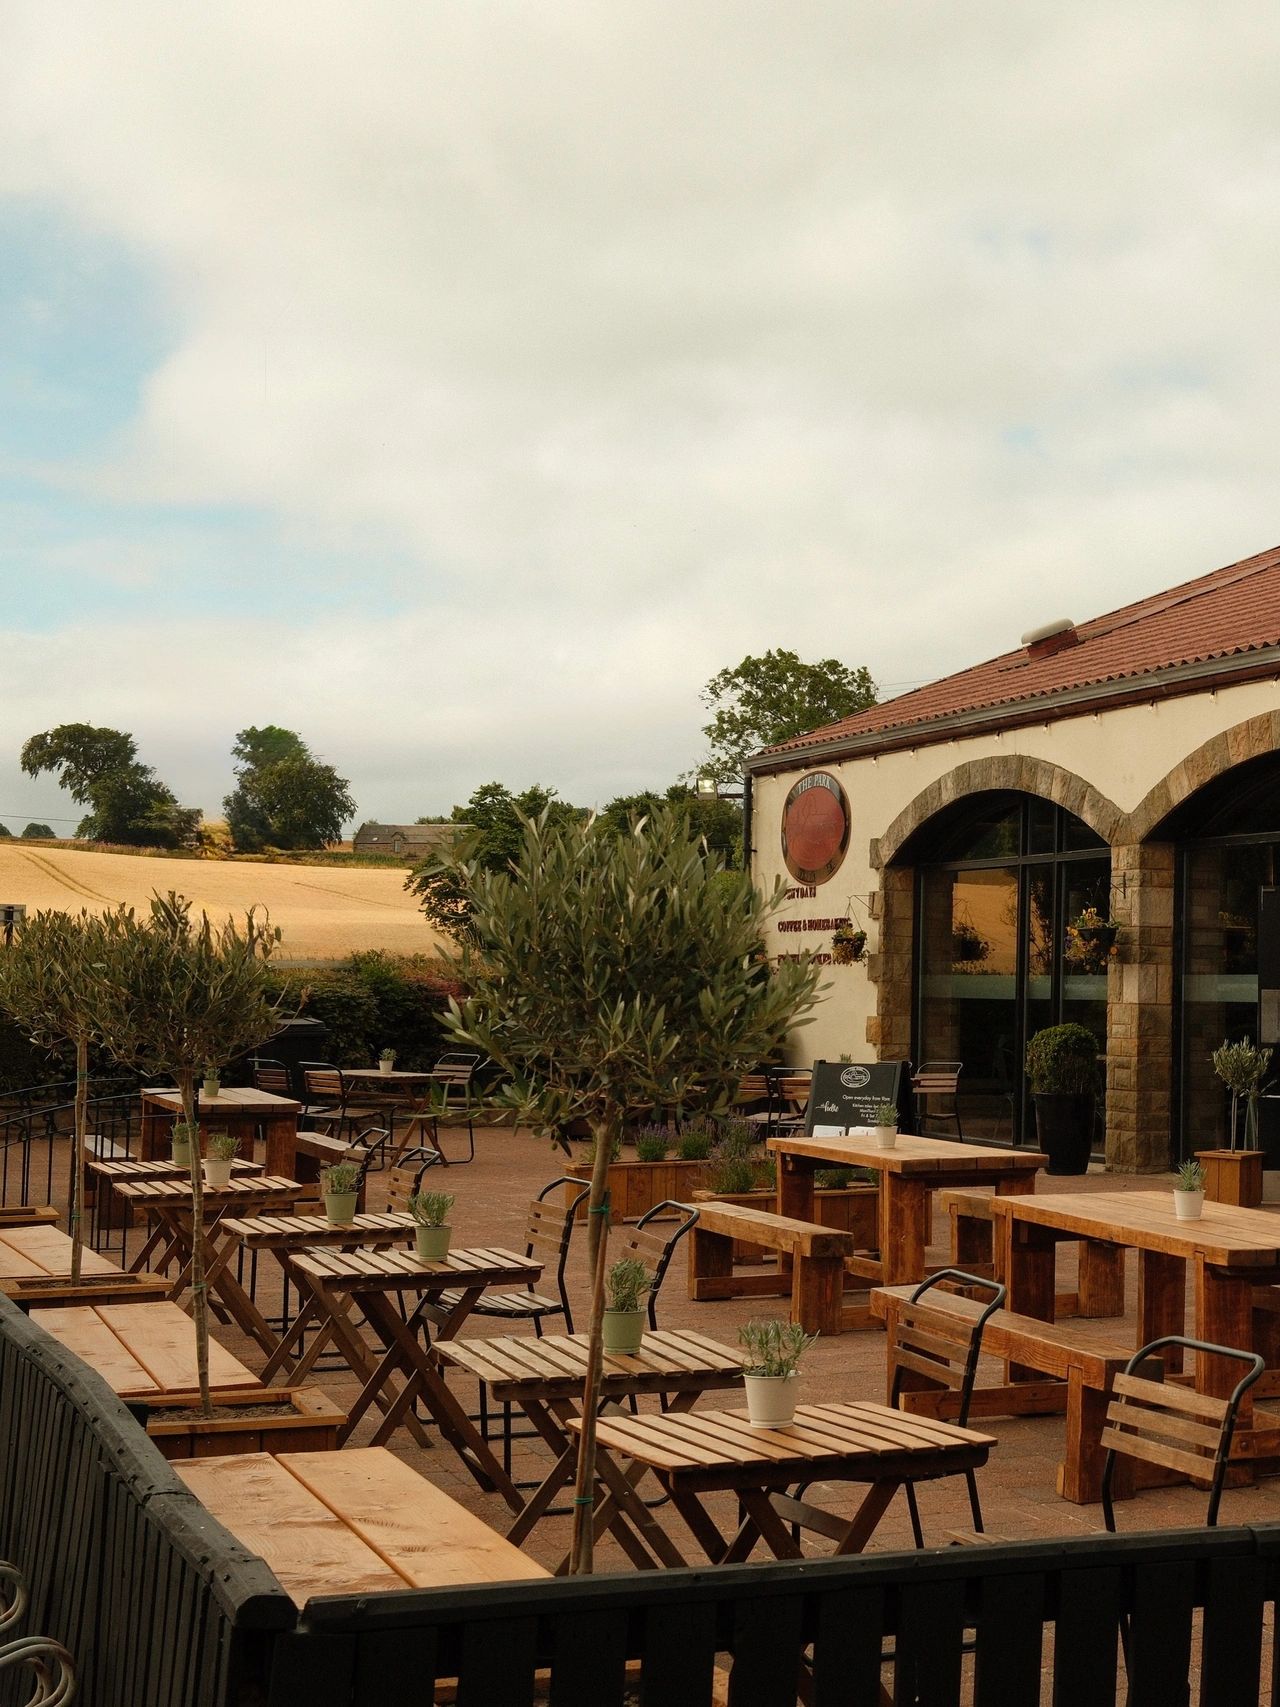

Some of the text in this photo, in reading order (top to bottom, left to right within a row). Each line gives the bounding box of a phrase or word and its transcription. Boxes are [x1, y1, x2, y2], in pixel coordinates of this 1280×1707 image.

[798, 774, 831, 794] THE PARK
[777, 919, 802, 933] COFFEE
